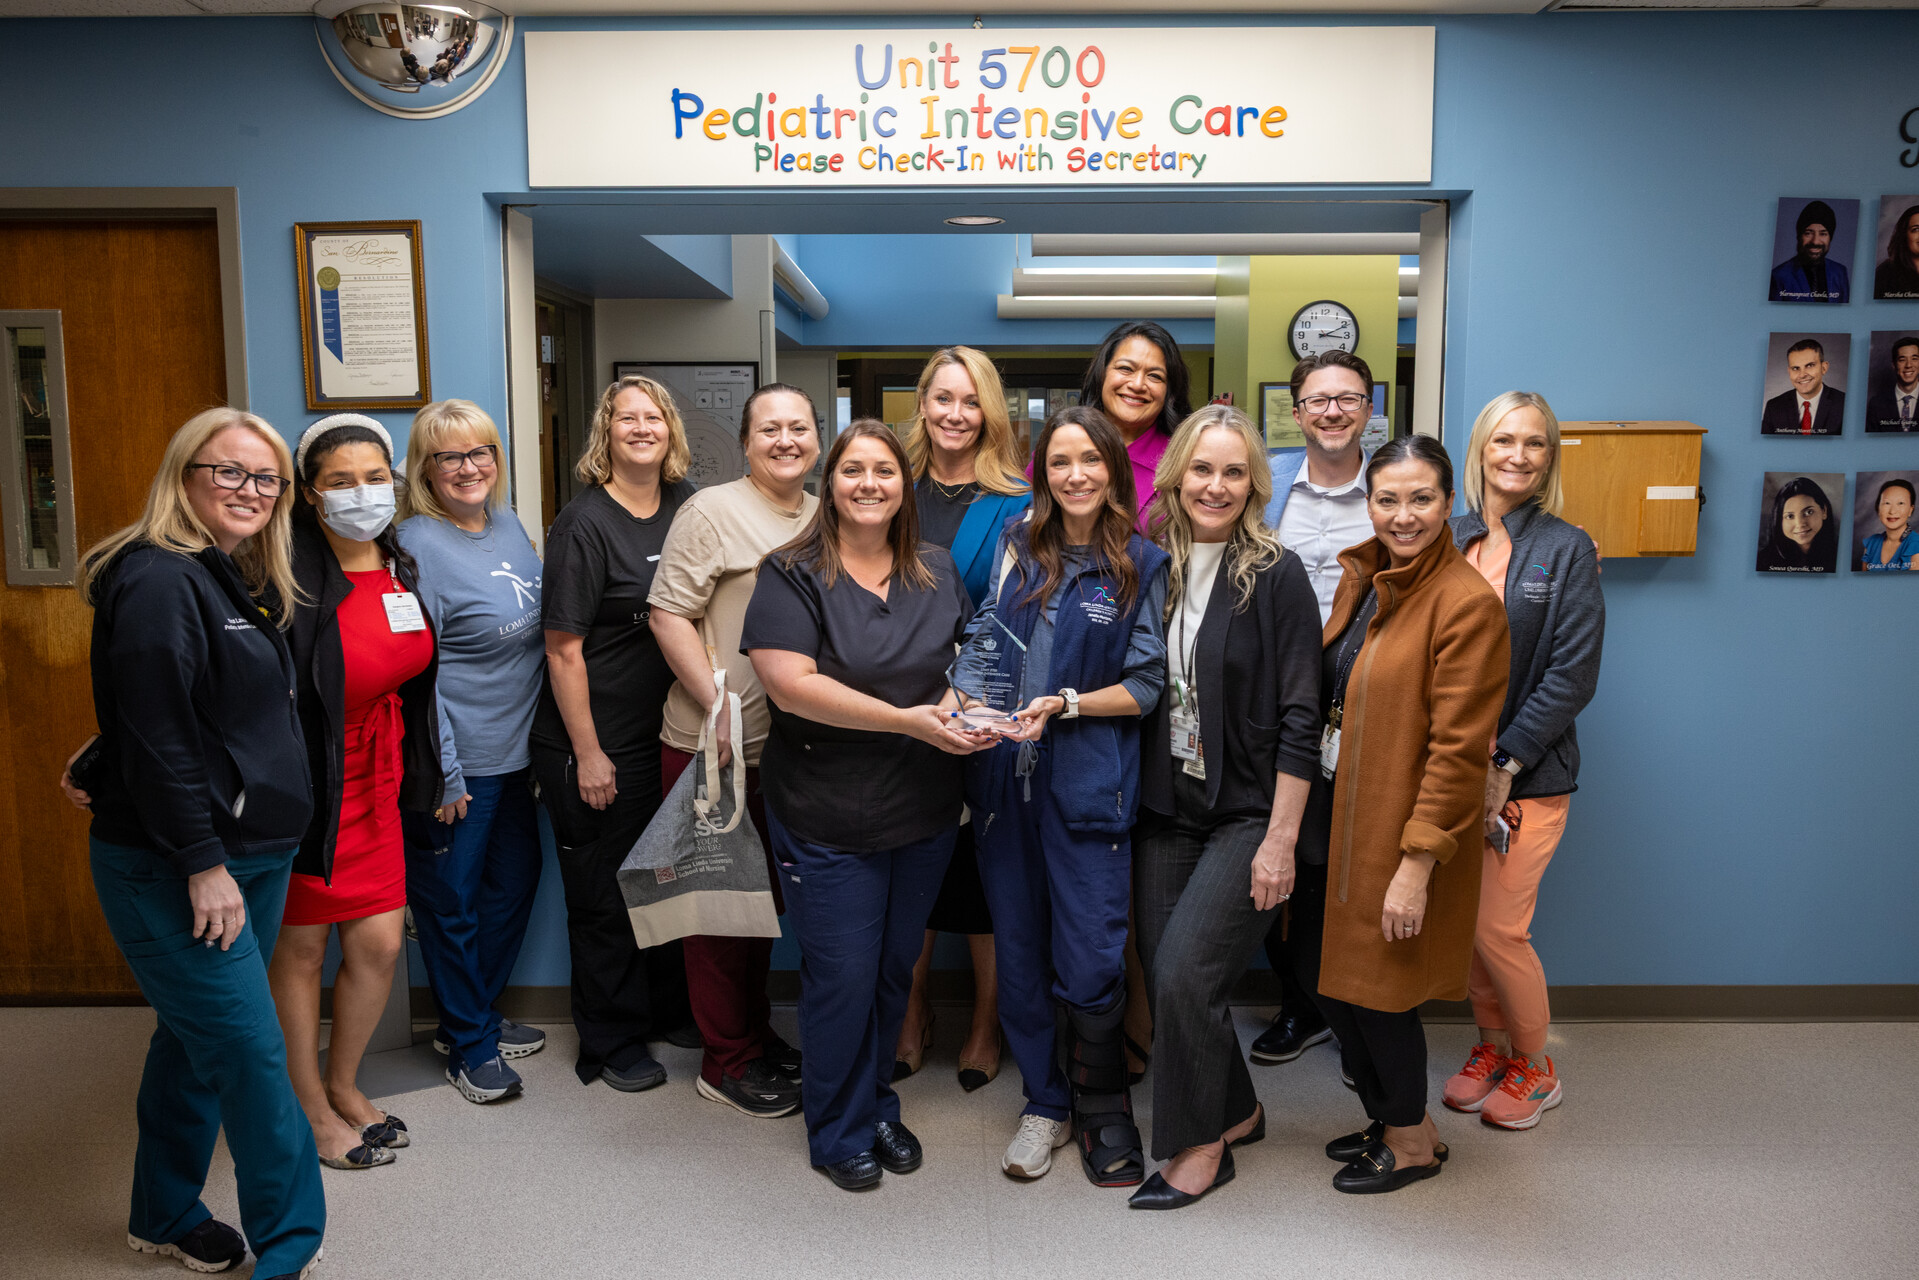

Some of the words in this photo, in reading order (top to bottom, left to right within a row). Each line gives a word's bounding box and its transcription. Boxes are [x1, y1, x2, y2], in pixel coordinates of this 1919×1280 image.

[855, 42, 960, 90] Unit
[979, 45, 1106, 92] 5700
[671, 87, 898, 141] Pediatric
[919, 91, 1144, 141] Intensive
[1169, 94, 1288, 139] Care
[754, 142, 845, 173] Please
[857, 145, 986, 172] Check-In
[997, 144, 1054, 172] with
[1066, 144, 1208, 178] Secretary
[321, 246, 339, 258] San
[1301, 321, 1311, 329] 10
[1341, 320, 1348, 329] 2
[1298, 331, 1305, 339] 9
[1343, 331, 1350, 339] 3
[1301, 342, 1308, 350] 8
[499, 617, 526, 636] LOMA
[696, 836, 719, 847] YOUR
[675, 862, 692, 872] Loma
[692, 858, 709, 868] Linda
[709, 856, 734, 865] University
[677, 866, 699, 879] School
[705, 864, 726, 873] Nursing
